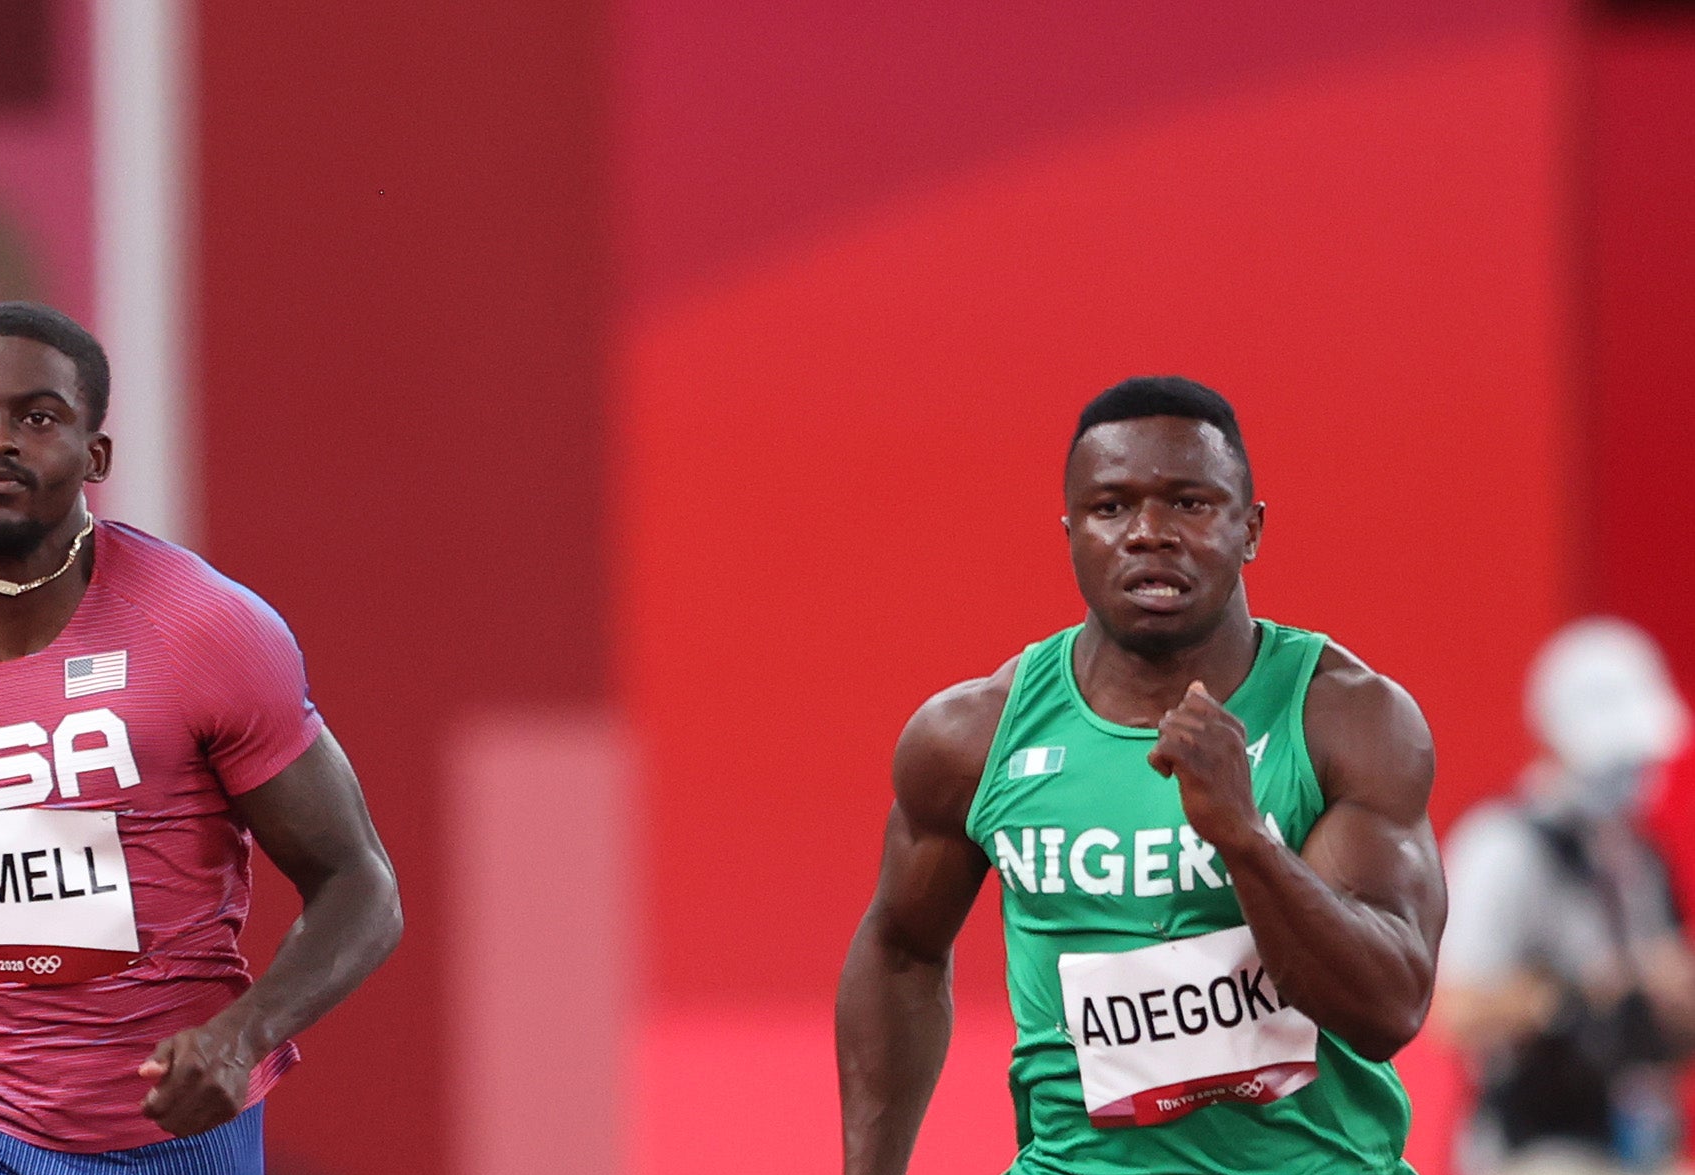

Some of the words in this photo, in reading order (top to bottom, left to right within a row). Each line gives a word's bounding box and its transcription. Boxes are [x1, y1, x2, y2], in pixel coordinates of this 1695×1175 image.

[994, 812, 1287, 897] NIGER
[0, 959, 24, 971] 2020
[1082, 966, 1293, 1047] ADEGOK
[1156, 1094, 1195, 1112] TOKYO
